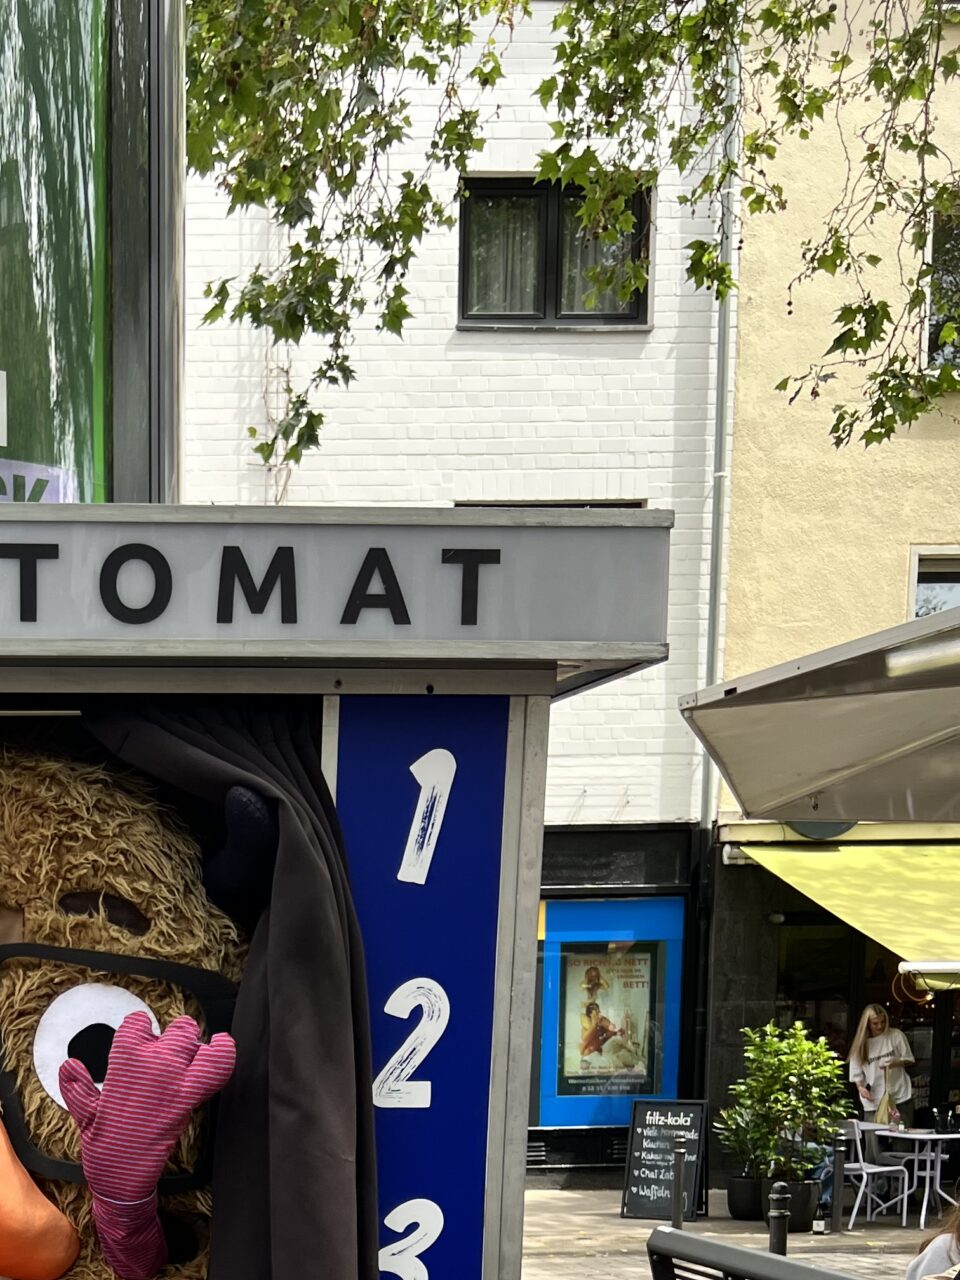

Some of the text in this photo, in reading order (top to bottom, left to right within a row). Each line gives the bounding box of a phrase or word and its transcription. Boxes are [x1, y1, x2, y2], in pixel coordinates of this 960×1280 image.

[397, 748, 457, 885] 1
[372, 977, 450, 1108] 2
[645, 1111, 691, 1126] fritz-kola
